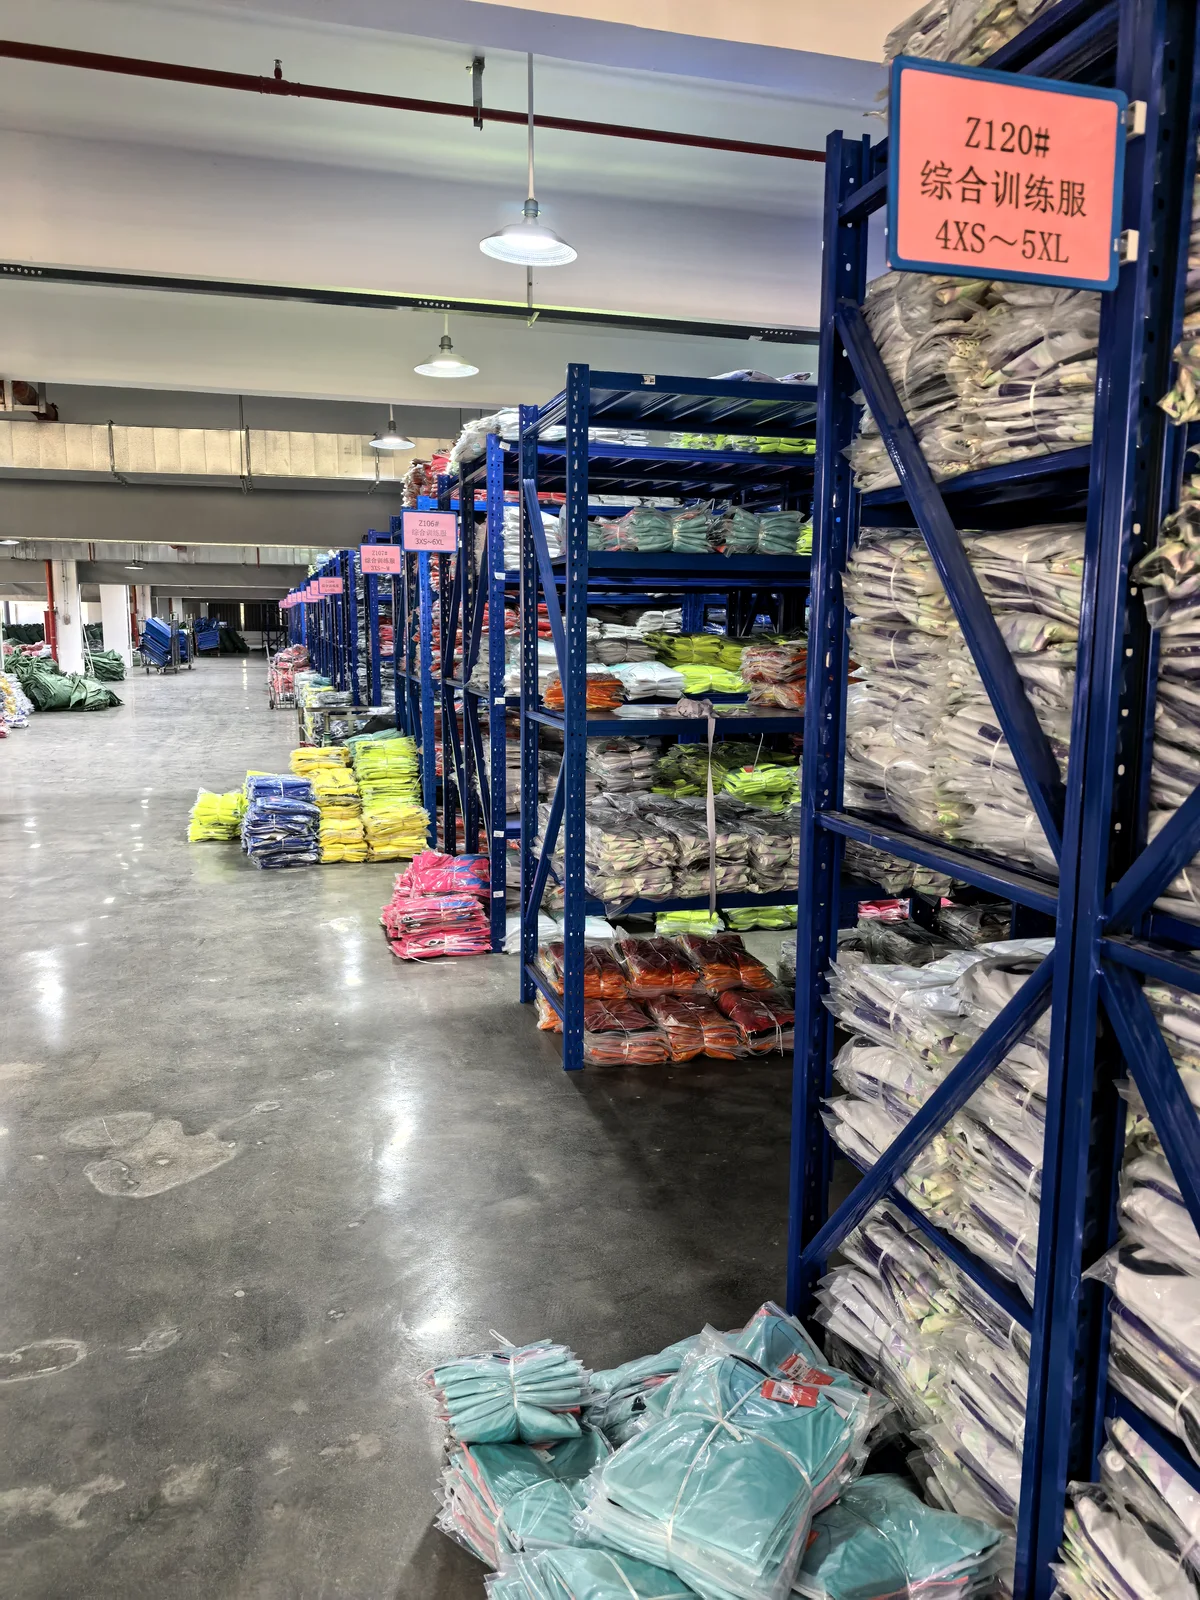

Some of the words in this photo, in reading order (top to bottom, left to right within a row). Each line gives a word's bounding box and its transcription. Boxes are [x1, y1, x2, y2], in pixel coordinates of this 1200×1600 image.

[964, 116, 1050, 157] Z120#
[920, 159, 1087, 218] 综合训练服
[418, 519, 440, 528] Z106#
